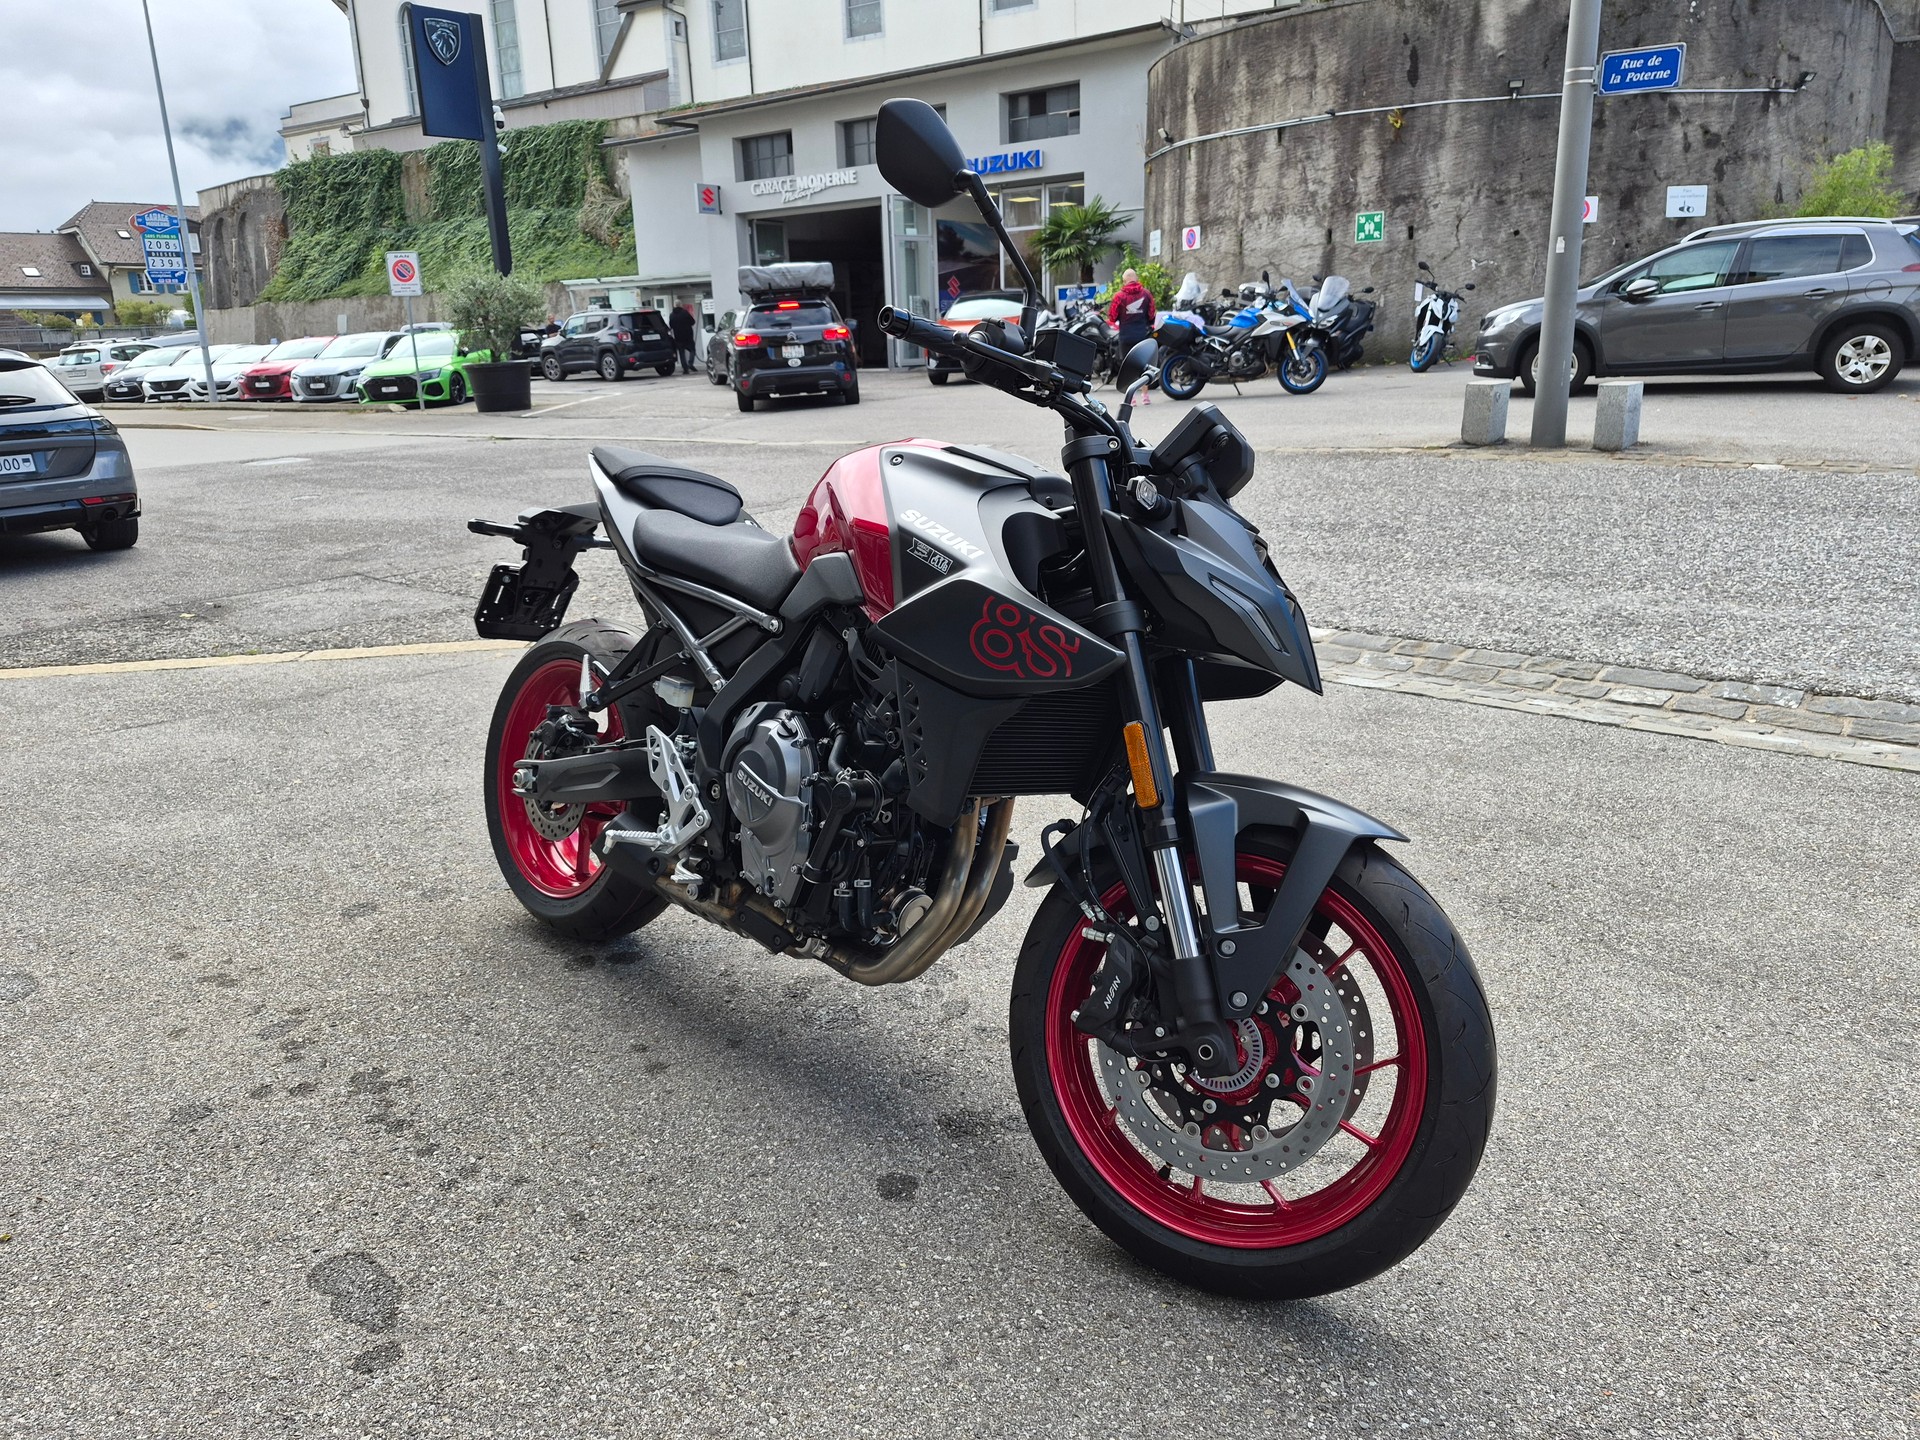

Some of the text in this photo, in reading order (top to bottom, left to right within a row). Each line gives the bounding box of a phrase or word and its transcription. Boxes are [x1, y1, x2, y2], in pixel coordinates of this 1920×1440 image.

[1620, 55, 1662, 70] Rue de
[1609, 69, 1671, 85] la Poterne
[750, 169, 857, 196] GARAGE MODERNE
[900, 509, 985, 560] SUZUKI
[736, 769, 774, 807] SUZUKI
